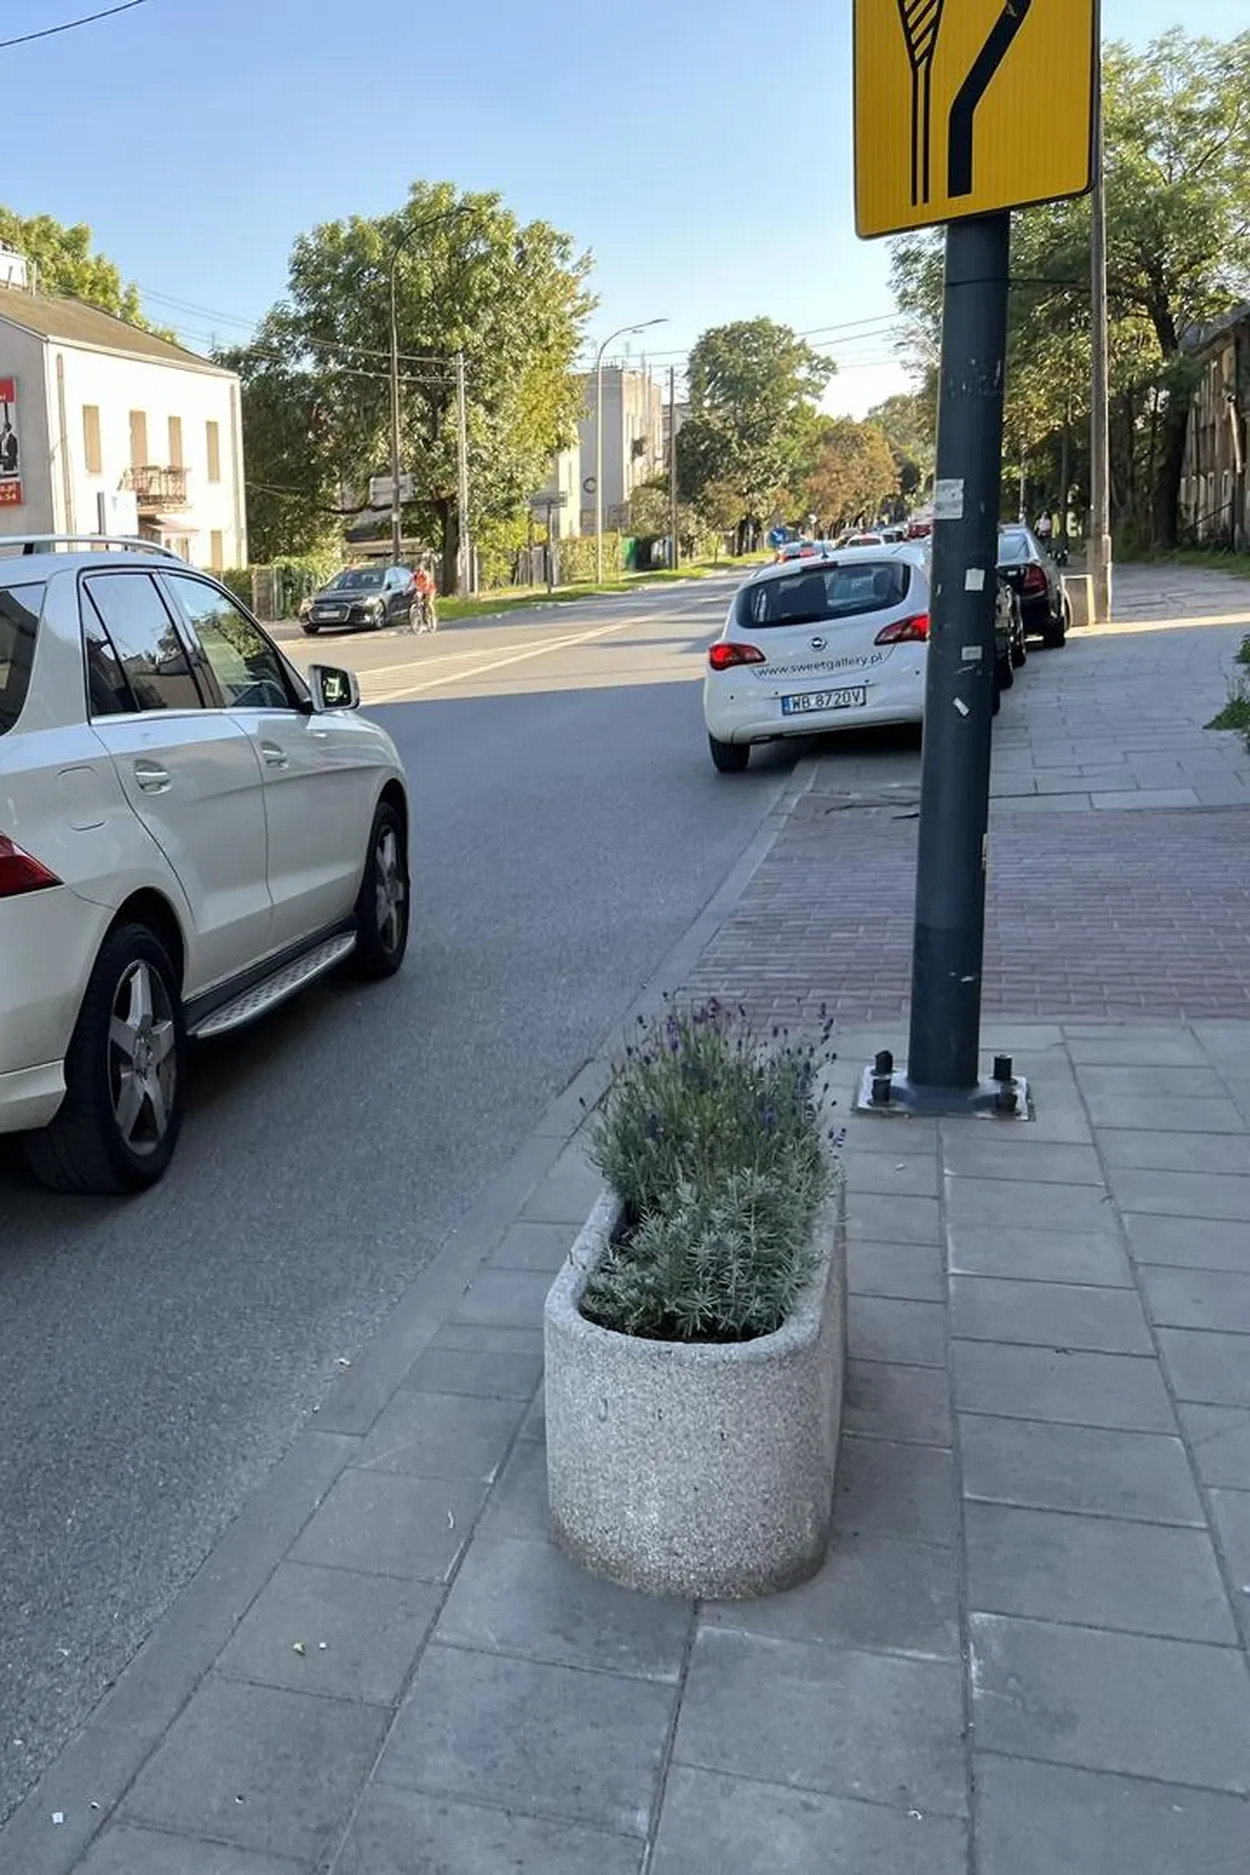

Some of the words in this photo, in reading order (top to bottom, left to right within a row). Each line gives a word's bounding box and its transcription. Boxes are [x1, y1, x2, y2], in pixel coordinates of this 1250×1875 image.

[758, 653, 883, 677] www.sweetgallery.pl
[792, 695, 811, 710] WB
[815, 690, 861, 708] 8720V
